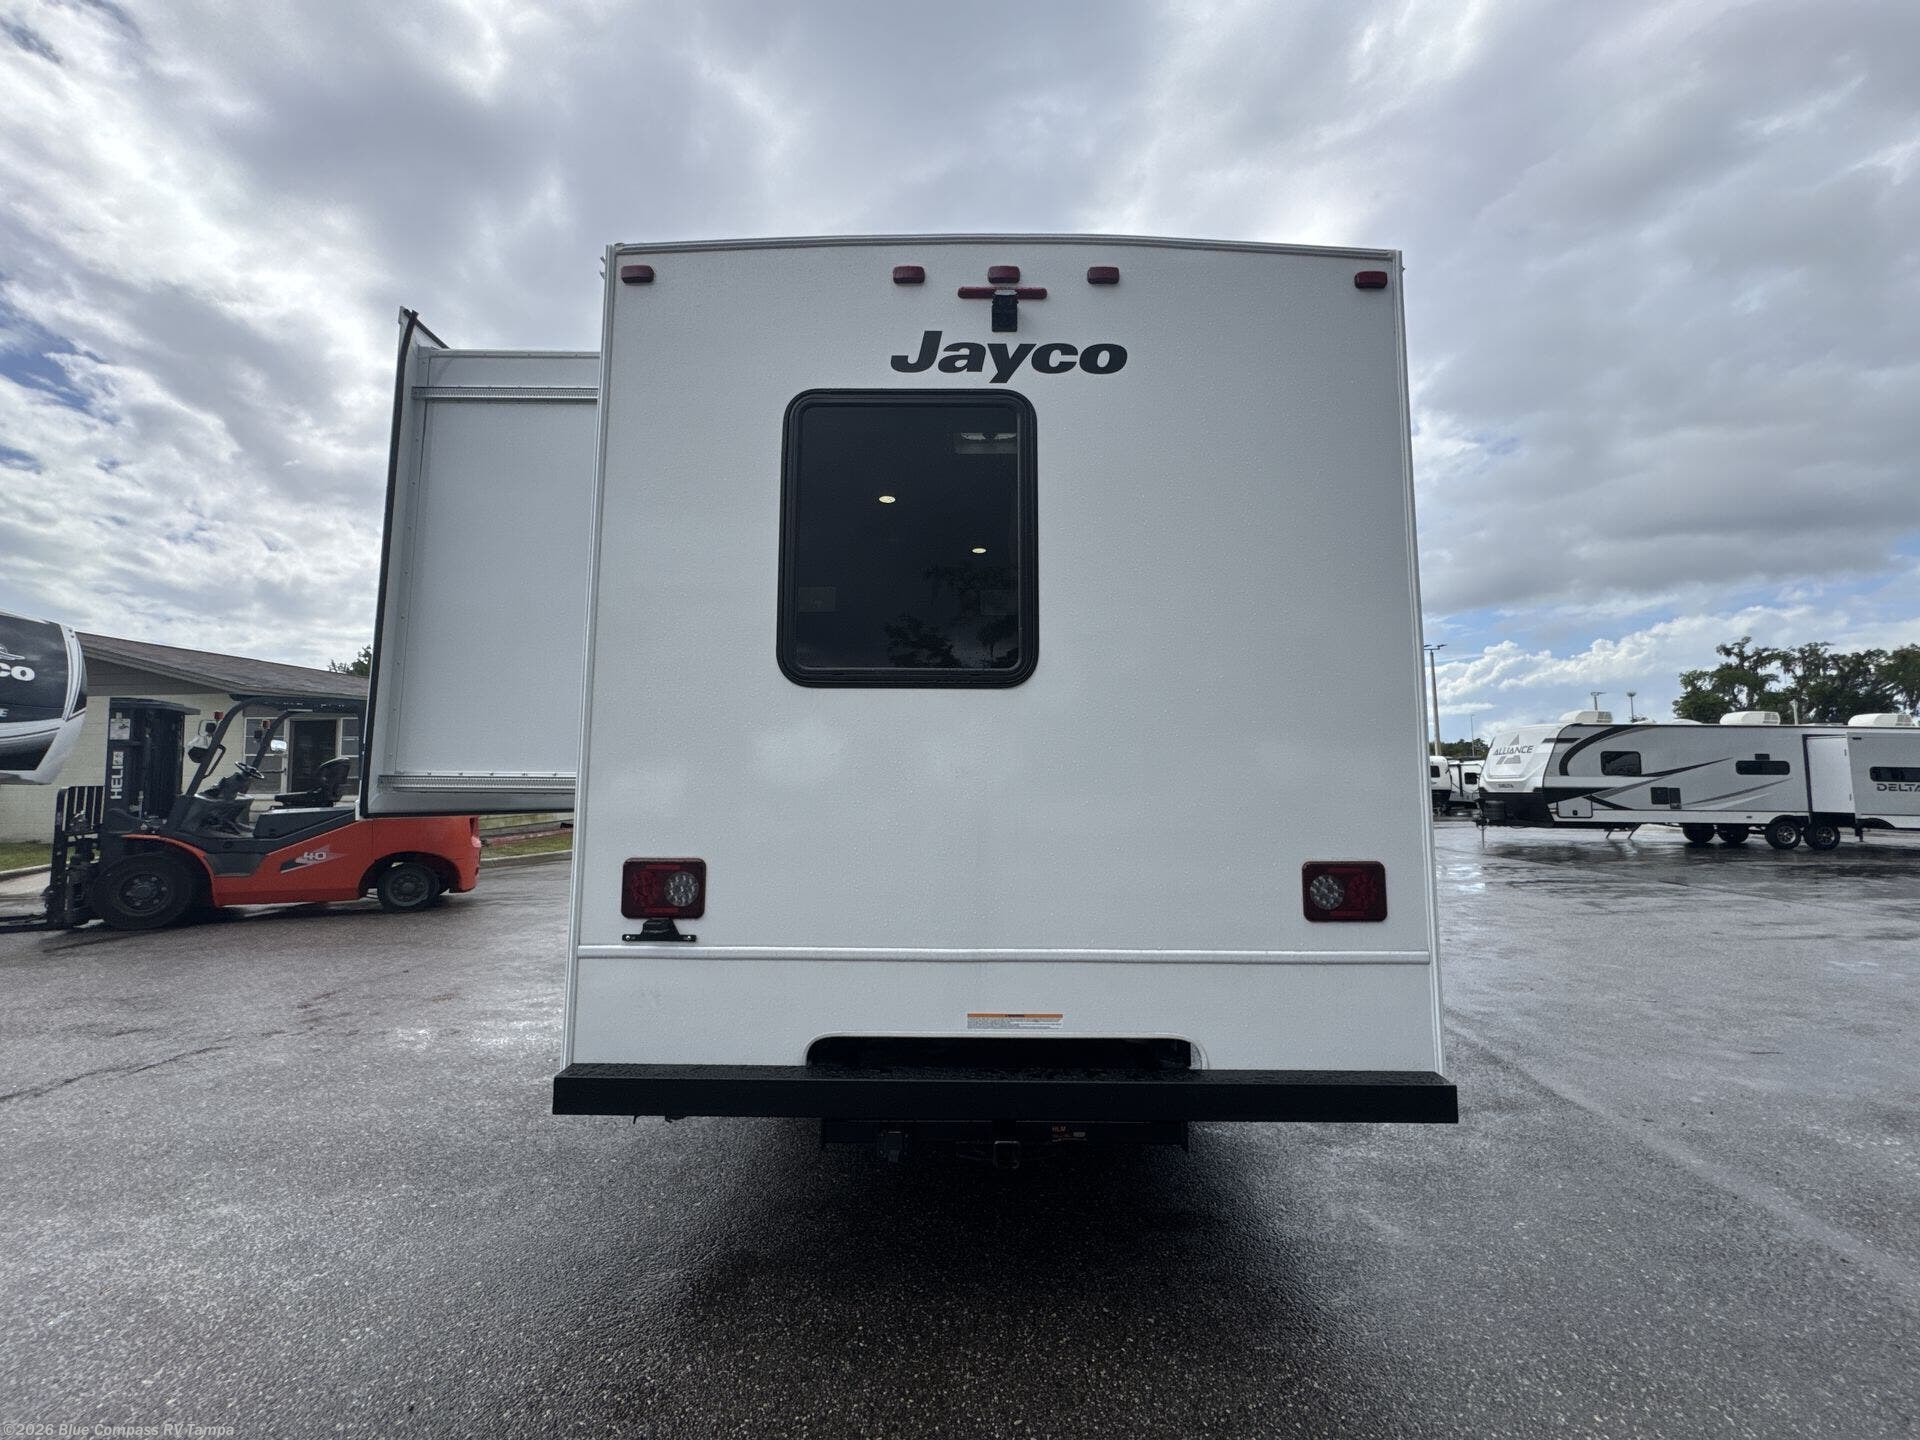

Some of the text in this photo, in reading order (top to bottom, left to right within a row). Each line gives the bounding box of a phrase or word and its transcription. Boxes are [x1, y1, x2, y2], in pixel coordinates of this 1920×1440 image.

[890, 330, 1128, 384] Jayco
[1493, 745, 1534, 755] ALLIANCE
[110, 765, 123, 800] HELI
[303, 852, 327, 861] 40
